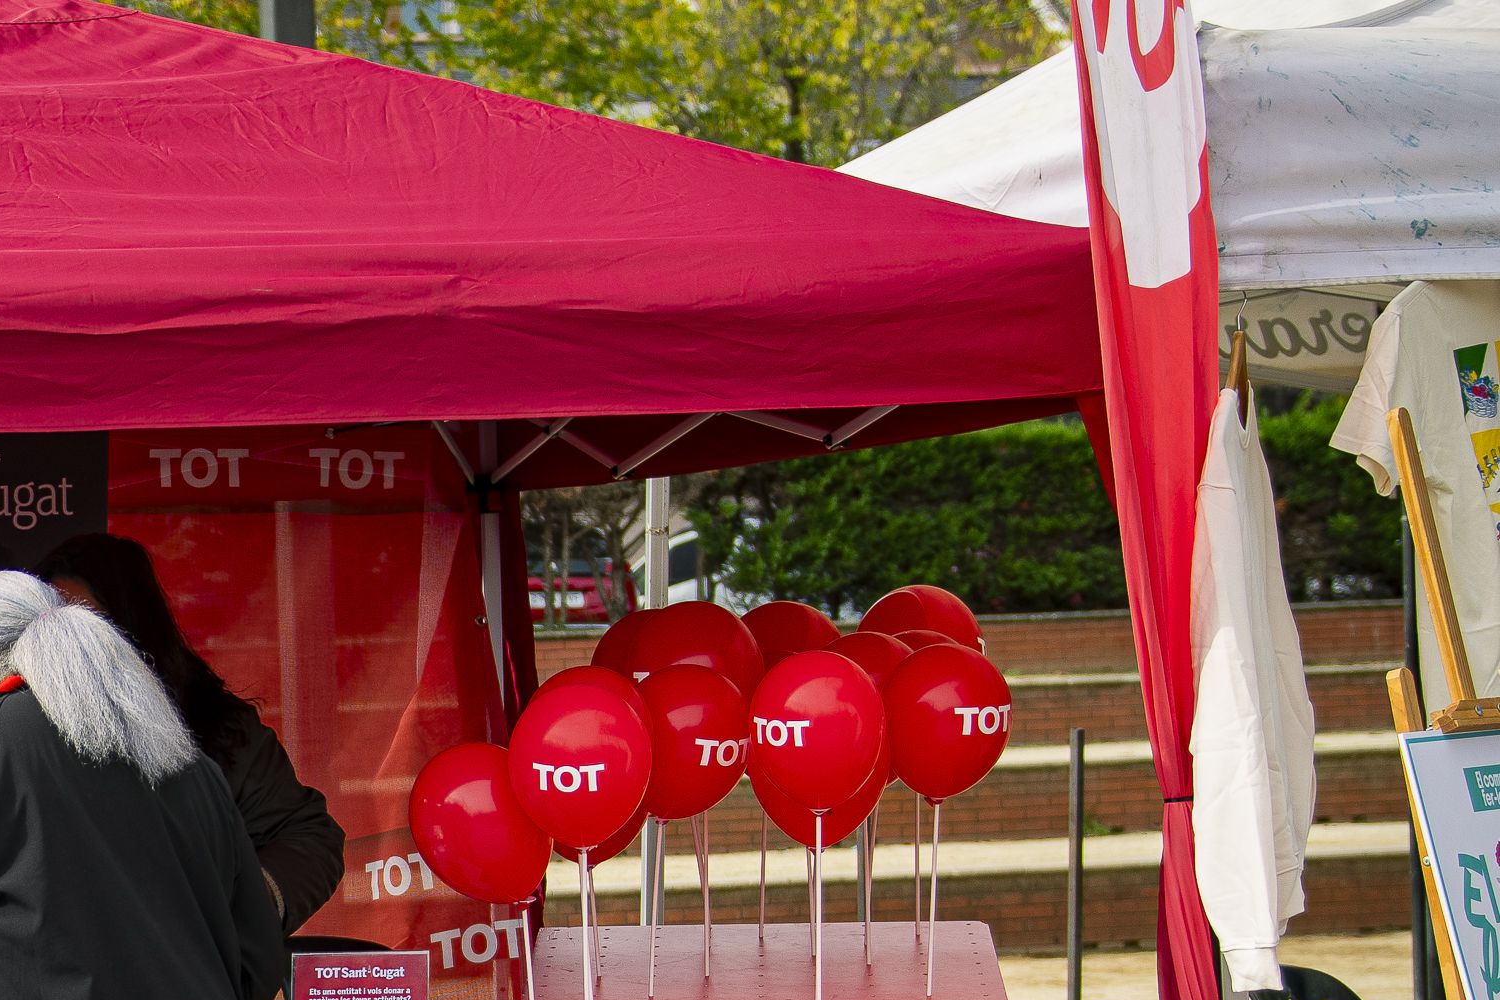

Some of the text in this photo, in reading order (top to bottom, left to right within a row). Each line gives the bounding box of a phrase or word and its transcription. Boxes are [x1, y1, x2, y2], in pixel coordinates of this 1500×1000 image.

[150, 447, 250, 488] TOT
[308, 447, 405, 490] TOT
[753, 716, 810, 747] TOT
[954, 704, 1011, 736] TOT
[695, 738, 750, 767] TOT
[532, 762, 605, 793] TOT
[430, 918, 522, 970] TOT
[315, 966, 405, 980] TOT Sant Cugat
[337, 987, 362, 995] entitat
